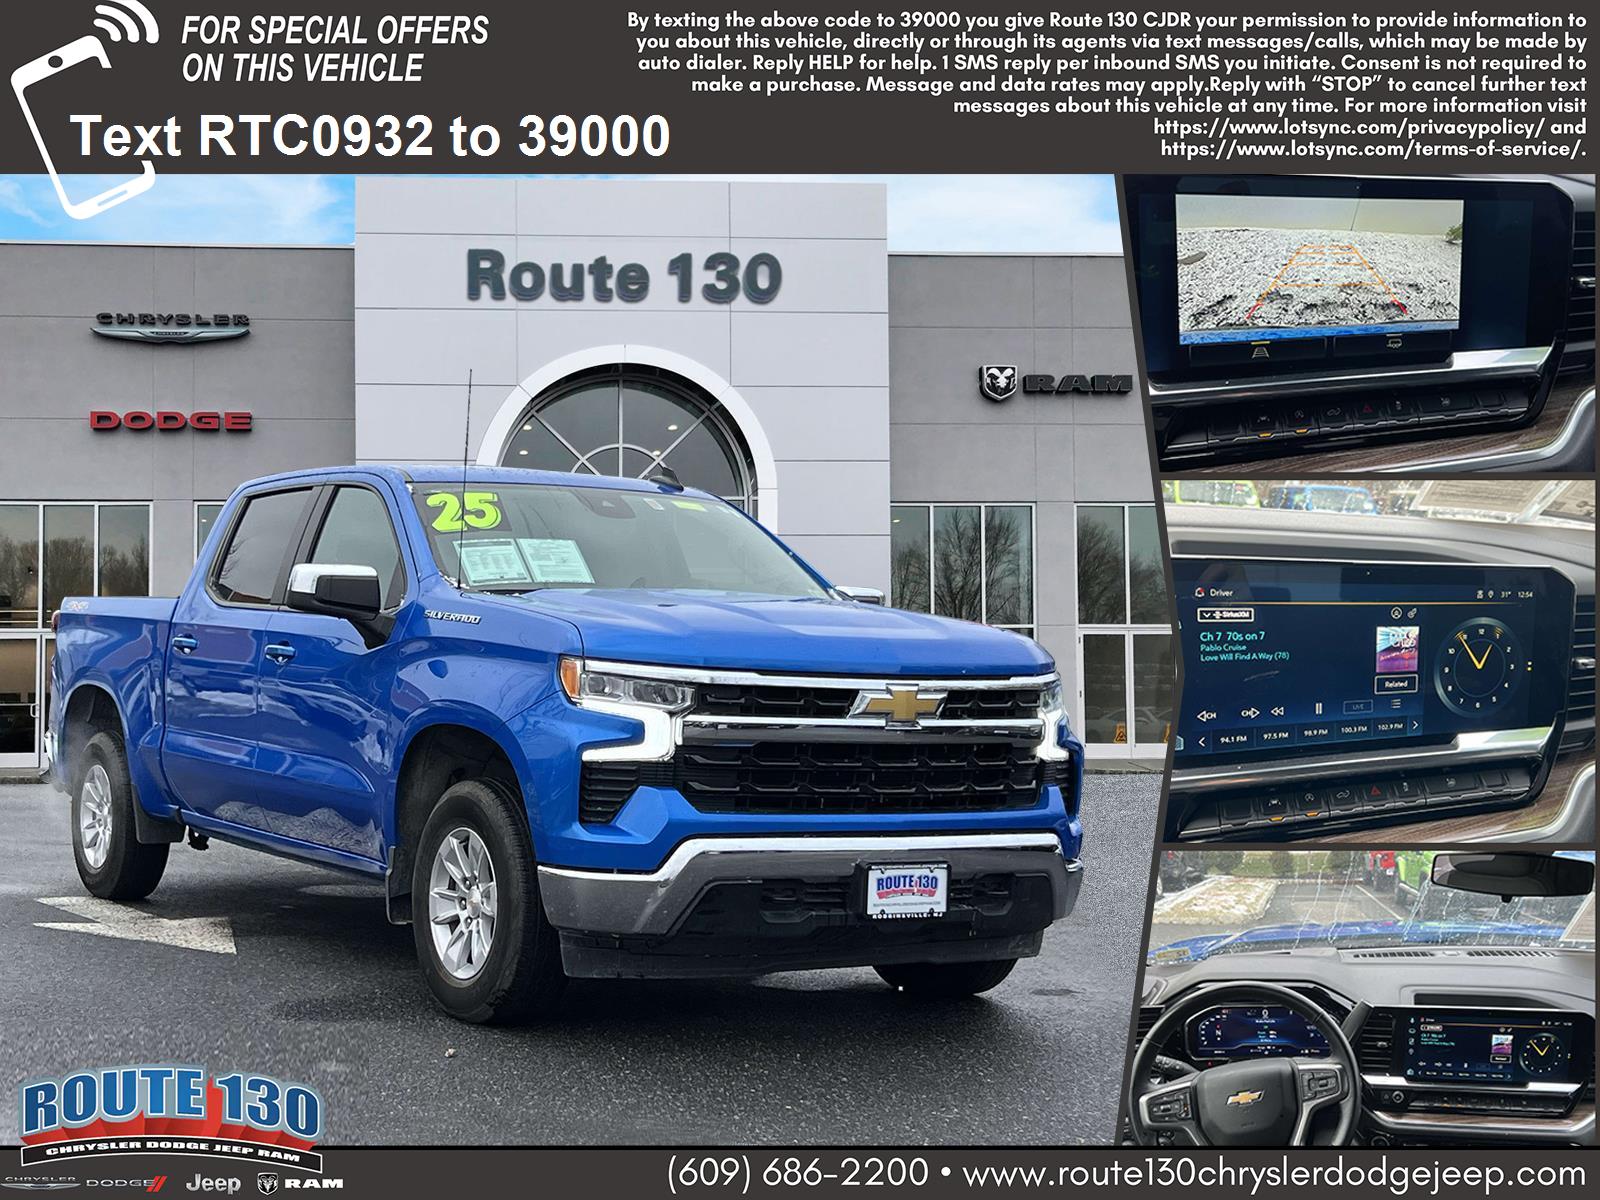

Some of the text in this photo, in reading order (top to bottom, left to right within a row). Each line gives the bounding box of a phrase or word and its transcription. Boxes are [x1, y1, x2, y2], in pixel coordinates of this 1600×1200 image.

[466, 248, 782, 305] Route 130
[96, 312, 250, 326] CHRYSLER
[1022, 374, 1134, 395] RAM
[89, 410, 253, 432] DODGE
[426, 491, 502, 533] 25
[1209, 588, 1233, 597] Driver
[423, 609, 482, 625] SILVERADO
[1200, 631, 1214, 642] Ch
[1216, 632, 1222, 641] 7
[1226, 631, 1244, 641] 70s
[1259, 631, 1266, 641] 7
[1200, 643, 1247, 652] Pablo Cruise
[1200, 651, 1290, 662] Love Will Find A Way (78)
[1236, 735, 1247, 743] FM
[876, 874, 938, 890] ROUTE 130
